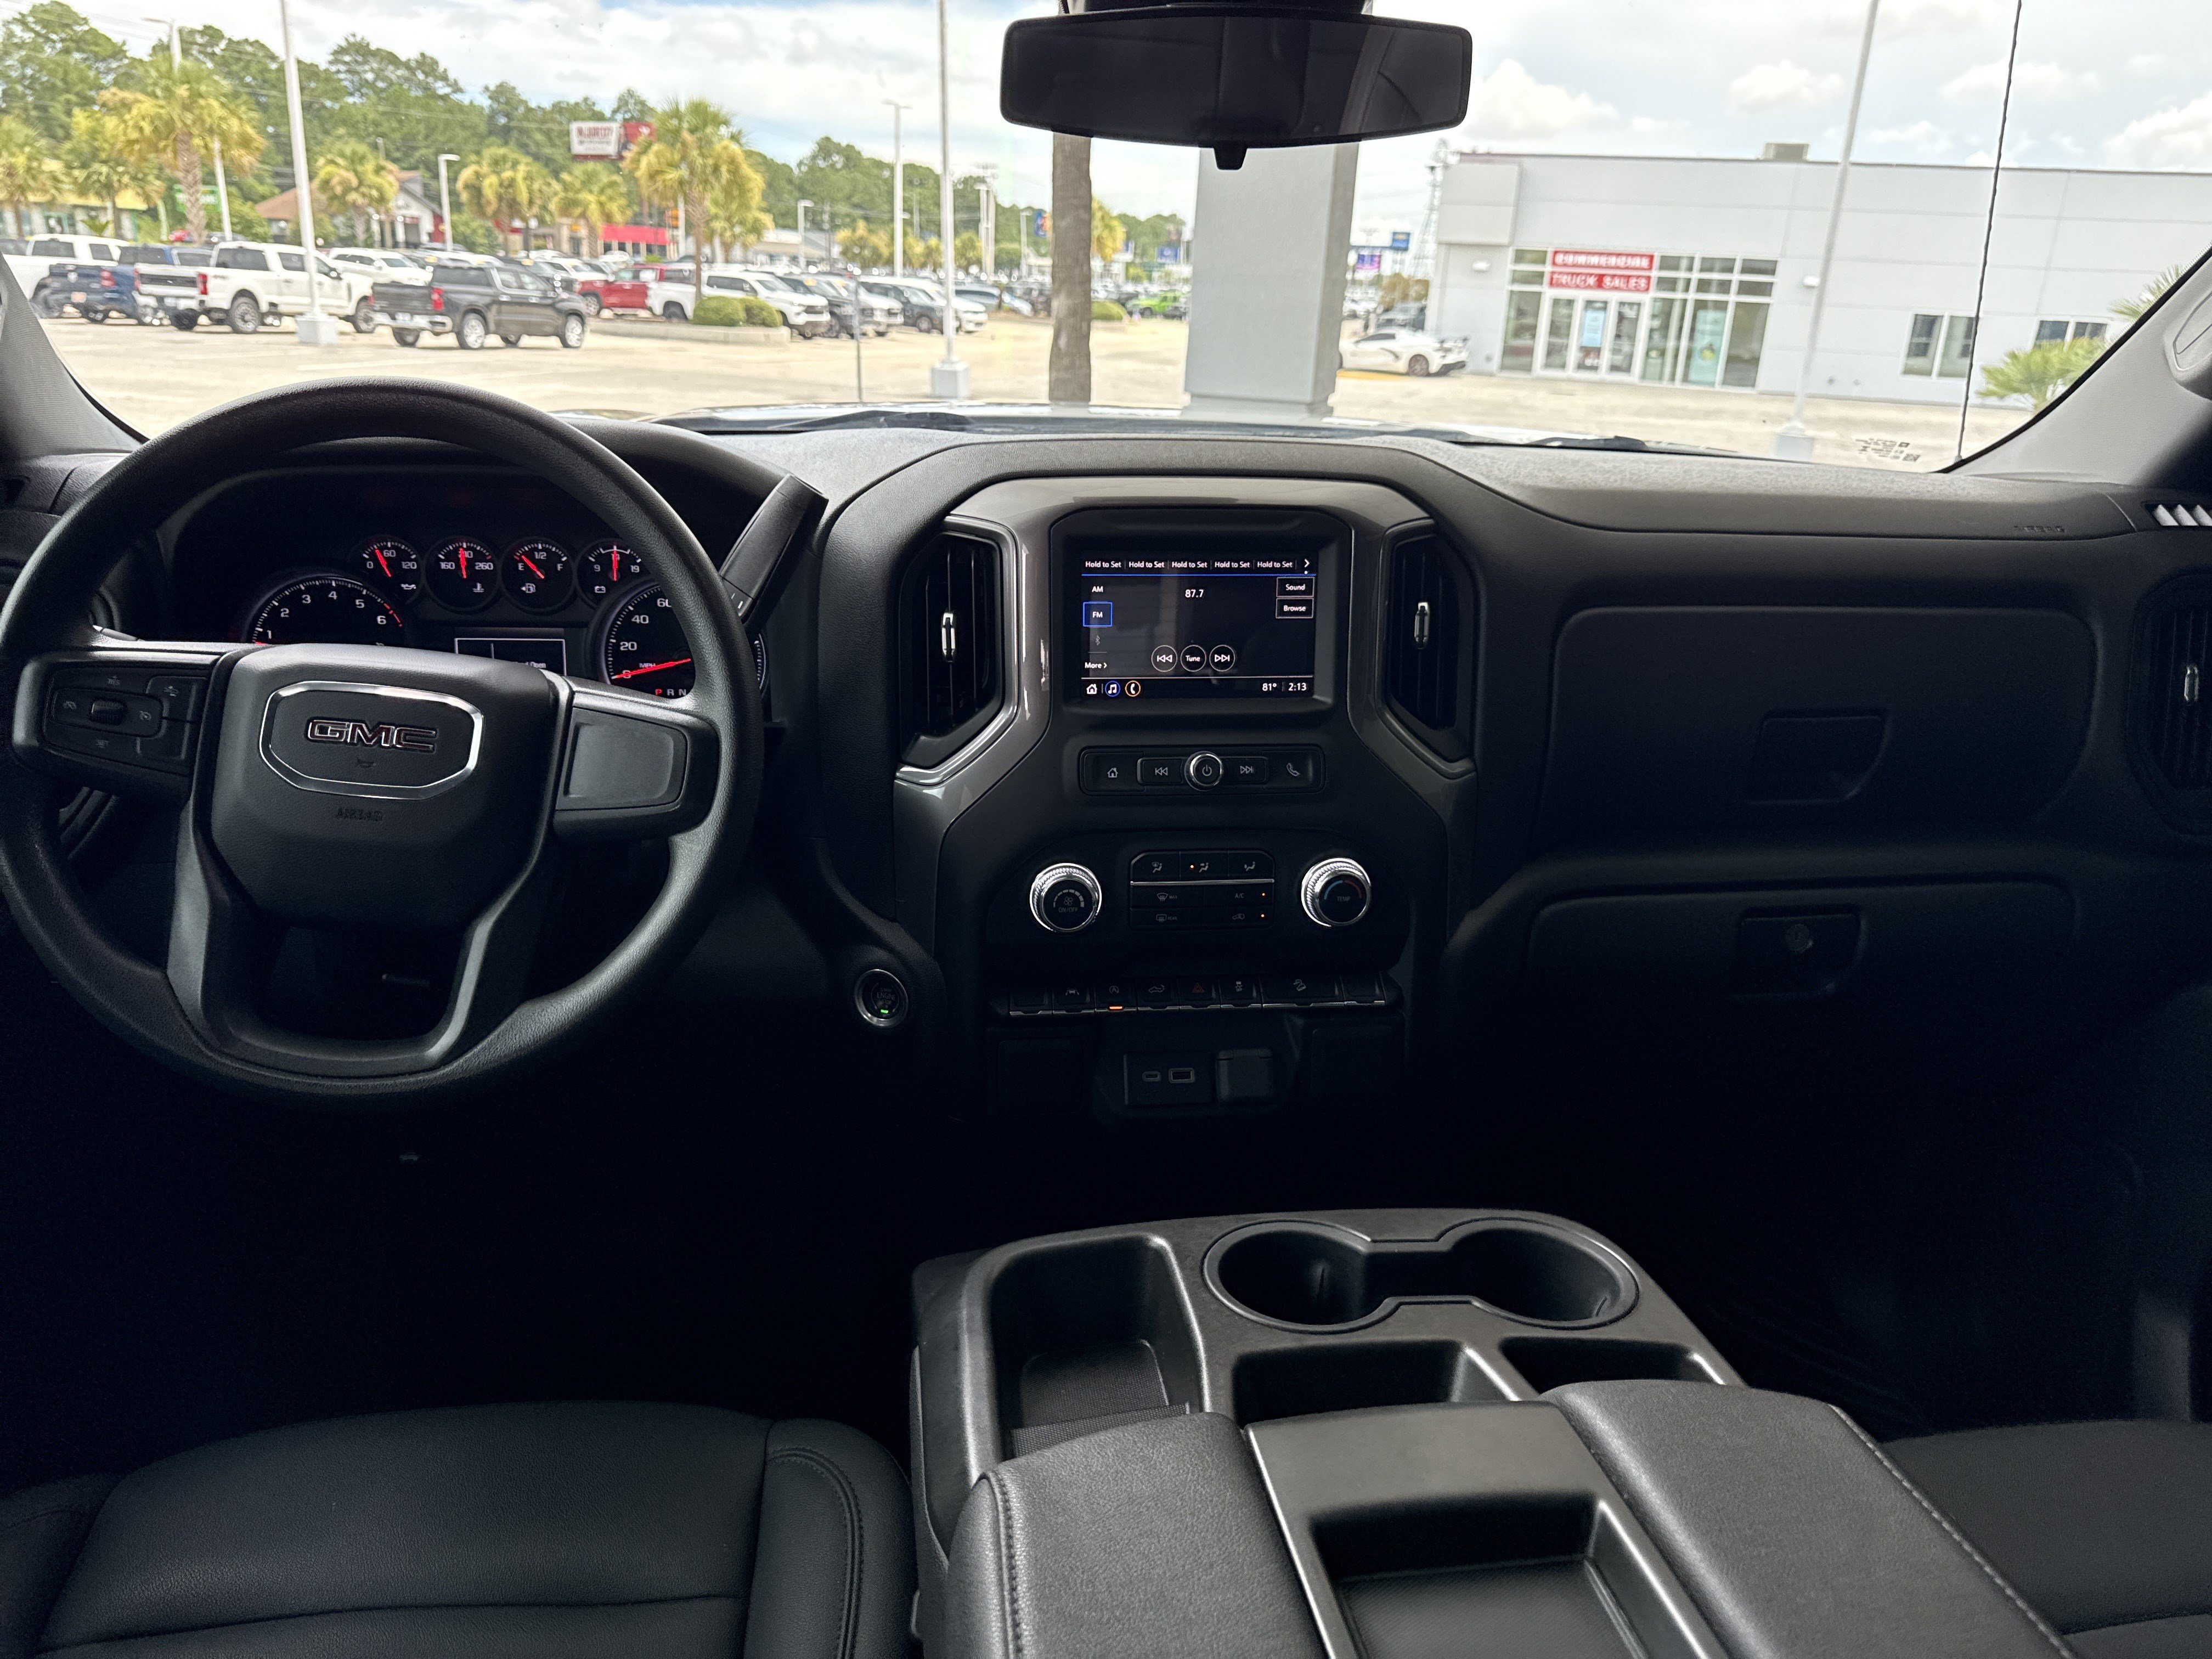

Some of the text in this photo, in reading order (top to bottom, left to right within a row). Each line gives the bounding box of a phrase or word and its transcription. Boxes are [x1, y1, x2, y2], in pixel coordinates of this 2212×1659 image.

[1552, 273, 1650, 291] TRUCK SALES
[383, 549, 396, 557] 60
[534, 551, 547, 560] 1/2
[366, 561, 374, 569] 0
[402, 561, 417, 569] 120
[439, 561, 455, 570] 160
[474, 562, 494, 571] 260
[517, 562, 524, 571] E
[557, 563, 564, 572] F
[594, 564, 601, 572] 9
[630, 565, 640, 573] 19
[328, 591, 338, 600] 4
[1185, 589, 1204, 598] 87.7
[302, 594, 312, 604] 3
[356, 599, 365, 608] 5
[280, 608, 290, 618] 2
[376, 615, 387, 625] 6
[631, 614, 650, 624] 40
[267, 630, 272, 640] 1
[620, 641, 637, 651] 20
[1288, 682, 1307, 691] 2:13
[654, 688, 663, 696] P
[307, 719, 437, 752] GMC
